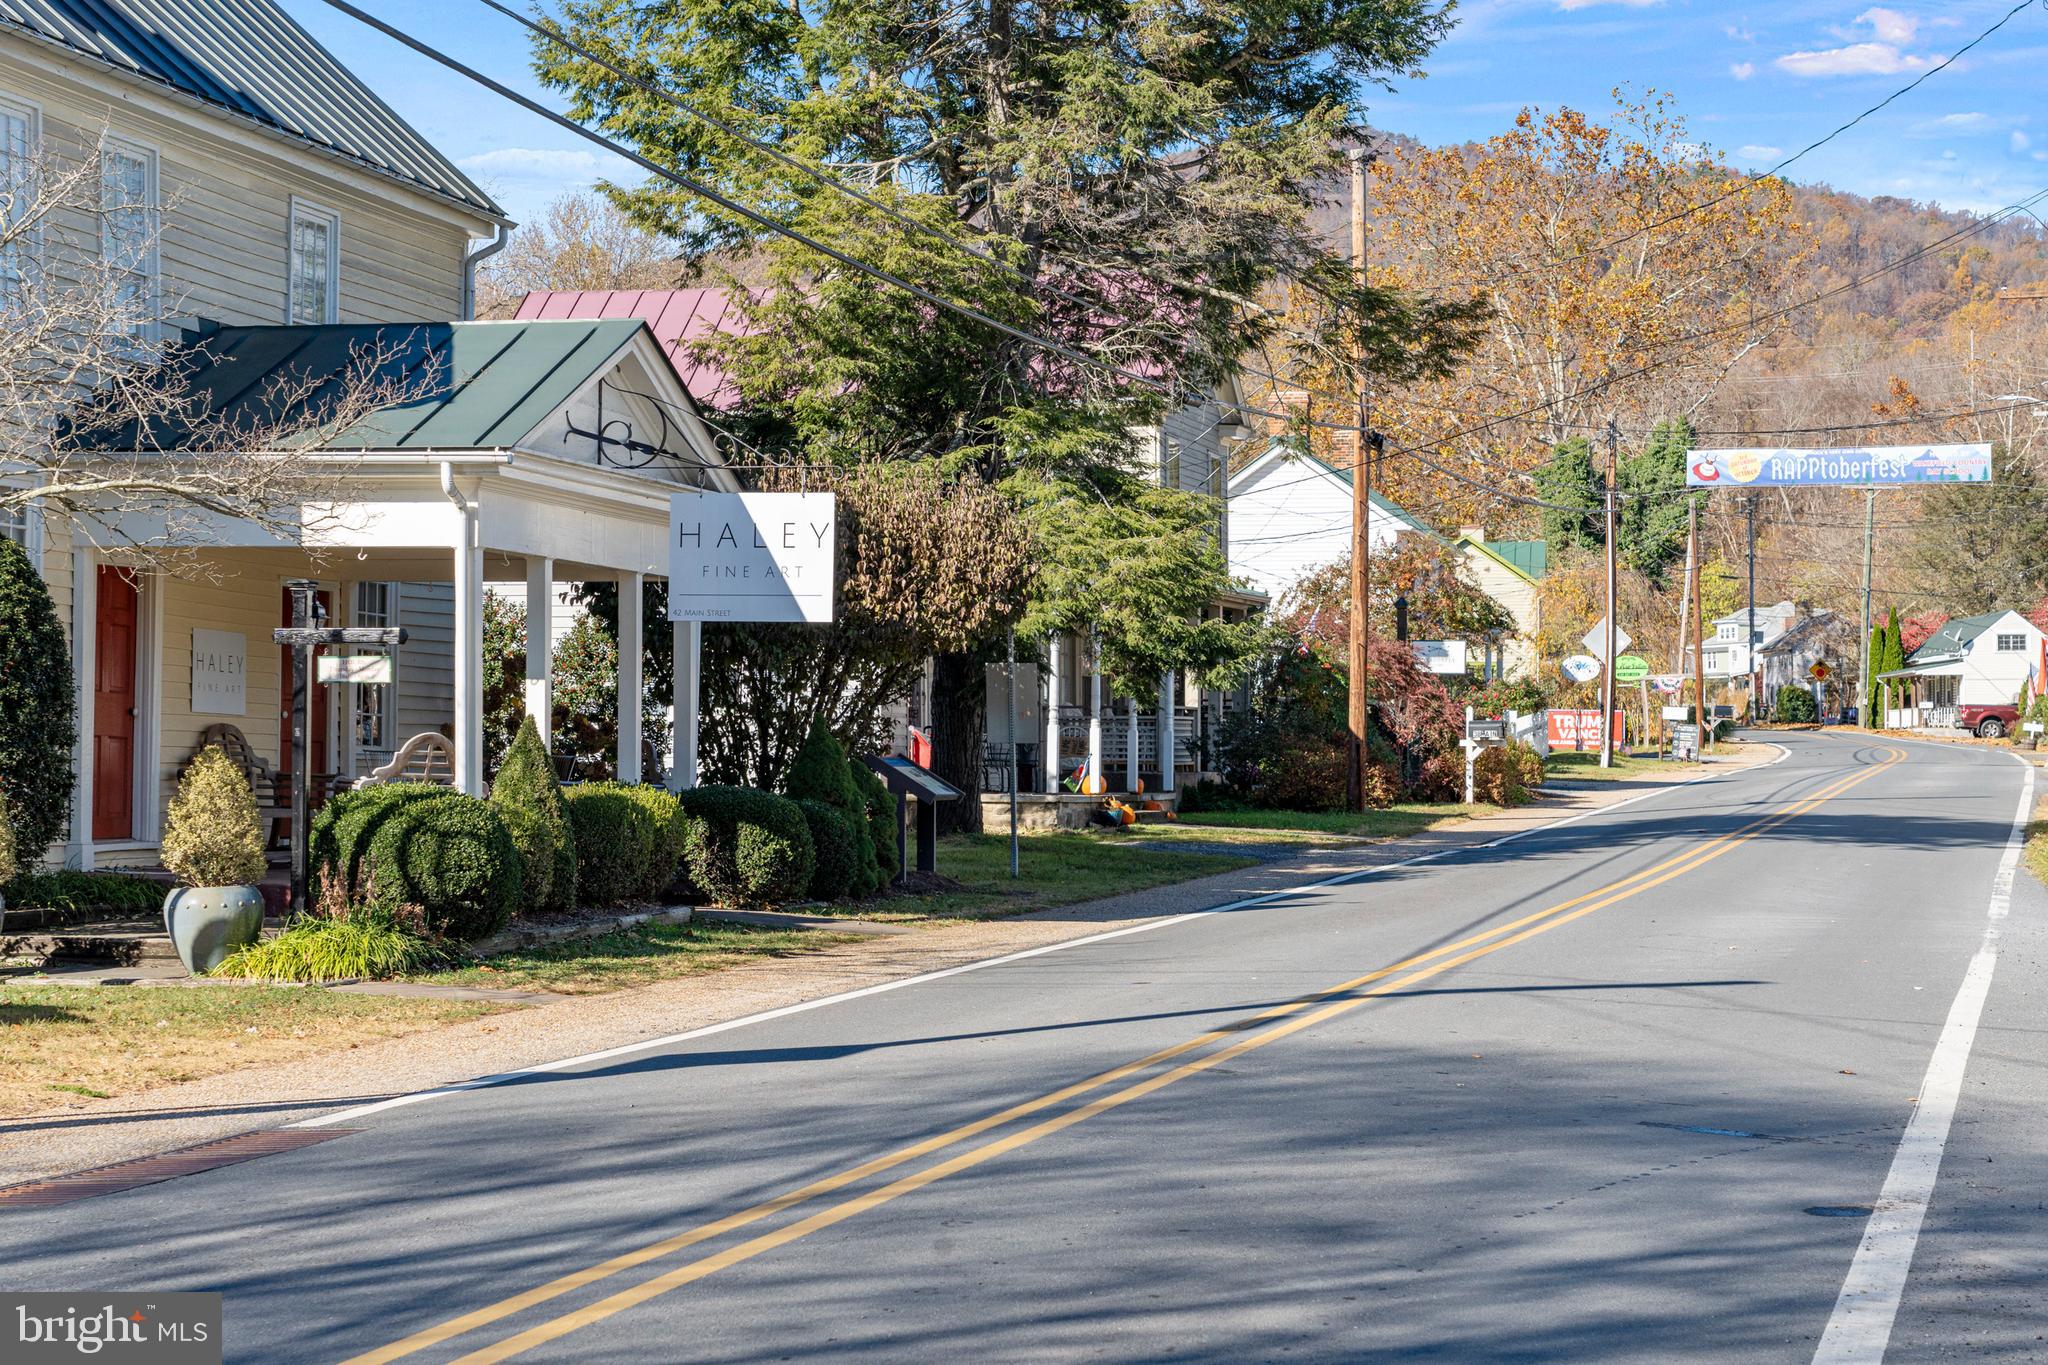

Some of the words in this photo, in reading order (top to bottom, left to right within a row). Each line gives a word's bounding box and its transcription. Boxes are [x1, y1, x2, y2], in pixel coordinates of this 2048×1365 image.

[1771, 455, 1909, 480] RAPPtoberfest
[679, 522, 830, 549] HALEY
[702, 565, 751, 578] FINE
[764, 565, 804, 578] ART
[684, 609, 707, 617] MAIN
[707, 609, 732, 617] STREET
[195, 651, 244, 675] HALEY
[197, 681, 220, 694] FINE
[224, 683, 242, 695] ART
[1553, 714, 1601, 729] TRUM
